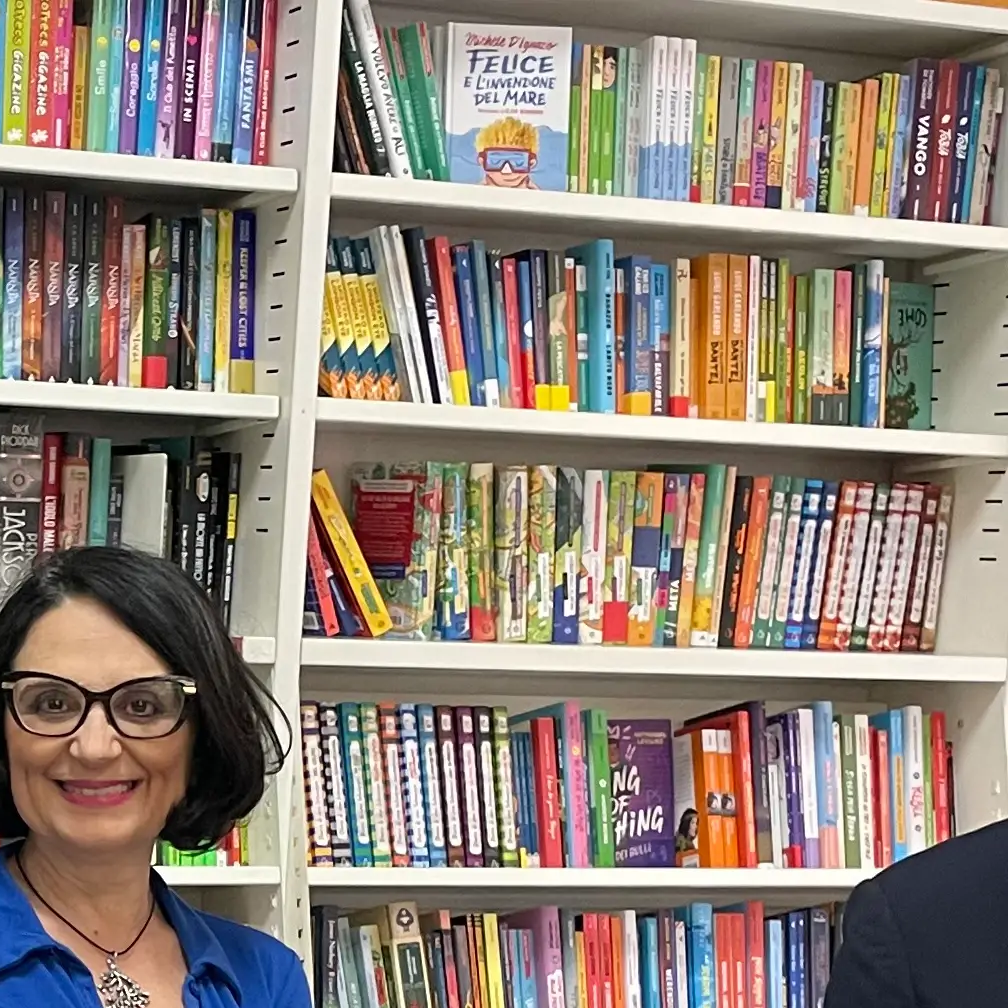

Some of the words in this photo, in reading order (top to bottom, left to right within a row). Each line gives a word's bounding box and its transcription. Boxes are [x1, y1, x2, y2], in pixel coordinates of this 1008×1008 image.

[165, 26, 177, 63] Fumetto
[466, 32, 506, 47] Michele
[94, 60, 107, 95] Smile
[354, 61, 363, 72] LA
[371, 47, 389, 89] VOLEVO
[466, 49, 554, 74] FELICE
[126, 62, 140, 117] Coraggio
[146, 60, 159, 101] Sorelle
[164, 83, 174, 103] Club
[183, 59, 196, 104] SCENA!
[240, 59, 254, 129] FANTASMI
[358, 74, 373, 109] MAGLIA
[464, 77, 473, 88] E
[476, 75, 556, 90] L'INVENZIONE
[474, 92, 500, 106] DEL
[503, 89, 546, 106] MARE
[183, 108, 193, 122] IN
[367, 109, 382, 143] NUMERO
[914, 115, 930, 176] VANGO
[239, 248, 248, 280] KEEPER
[238, 291, 248, 315] LOST
[713, 295, 722, 335] GARLANDO
[733, 293, 742, 334] GARLANDO
[238, 318, 248, 347] CITIES
[555, 341, 563, 354] LA
